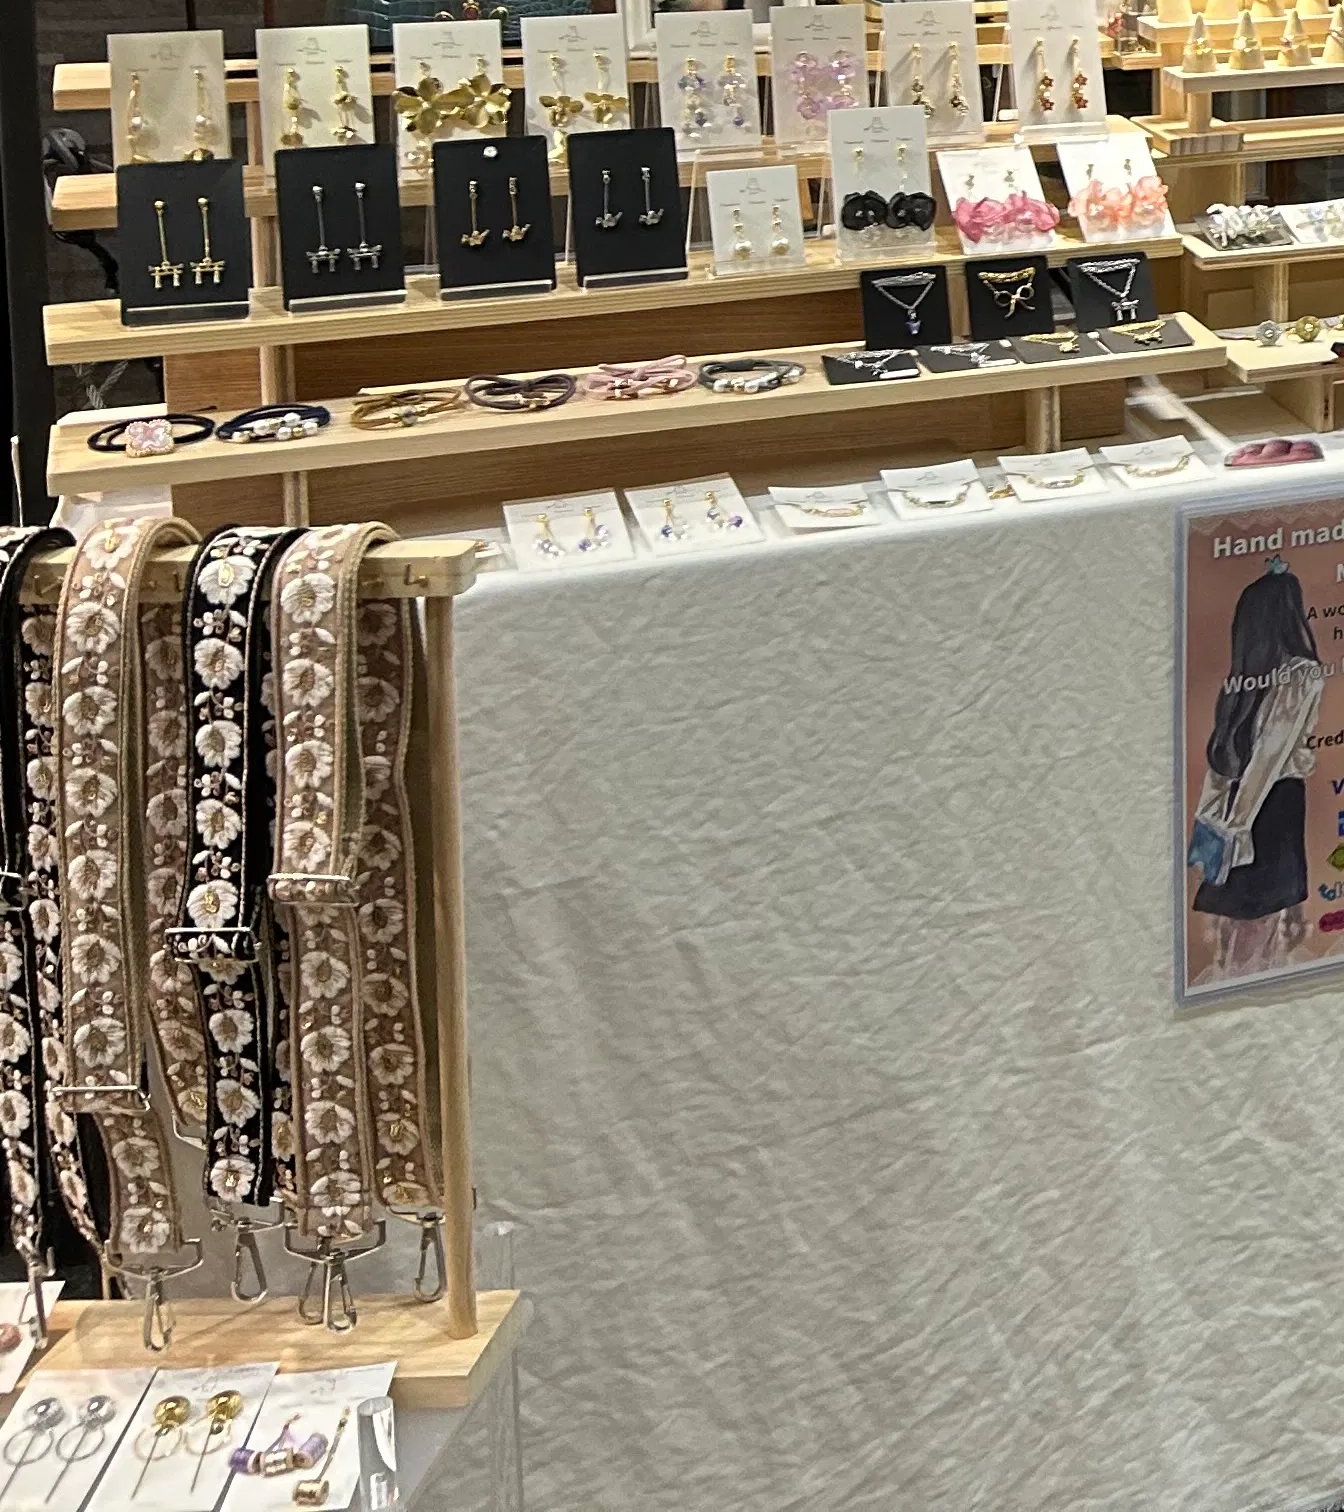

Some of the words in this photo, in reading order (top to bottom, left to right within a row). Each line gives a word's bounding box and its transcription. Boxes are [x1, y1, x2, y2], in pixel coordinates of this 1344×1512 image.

[1213, 527, 1283, 559] Hand
[1306, 606, 1320, 621] A
[1222, 661, 1293, 695] Would
[1297, 663, 1335, 690] you
